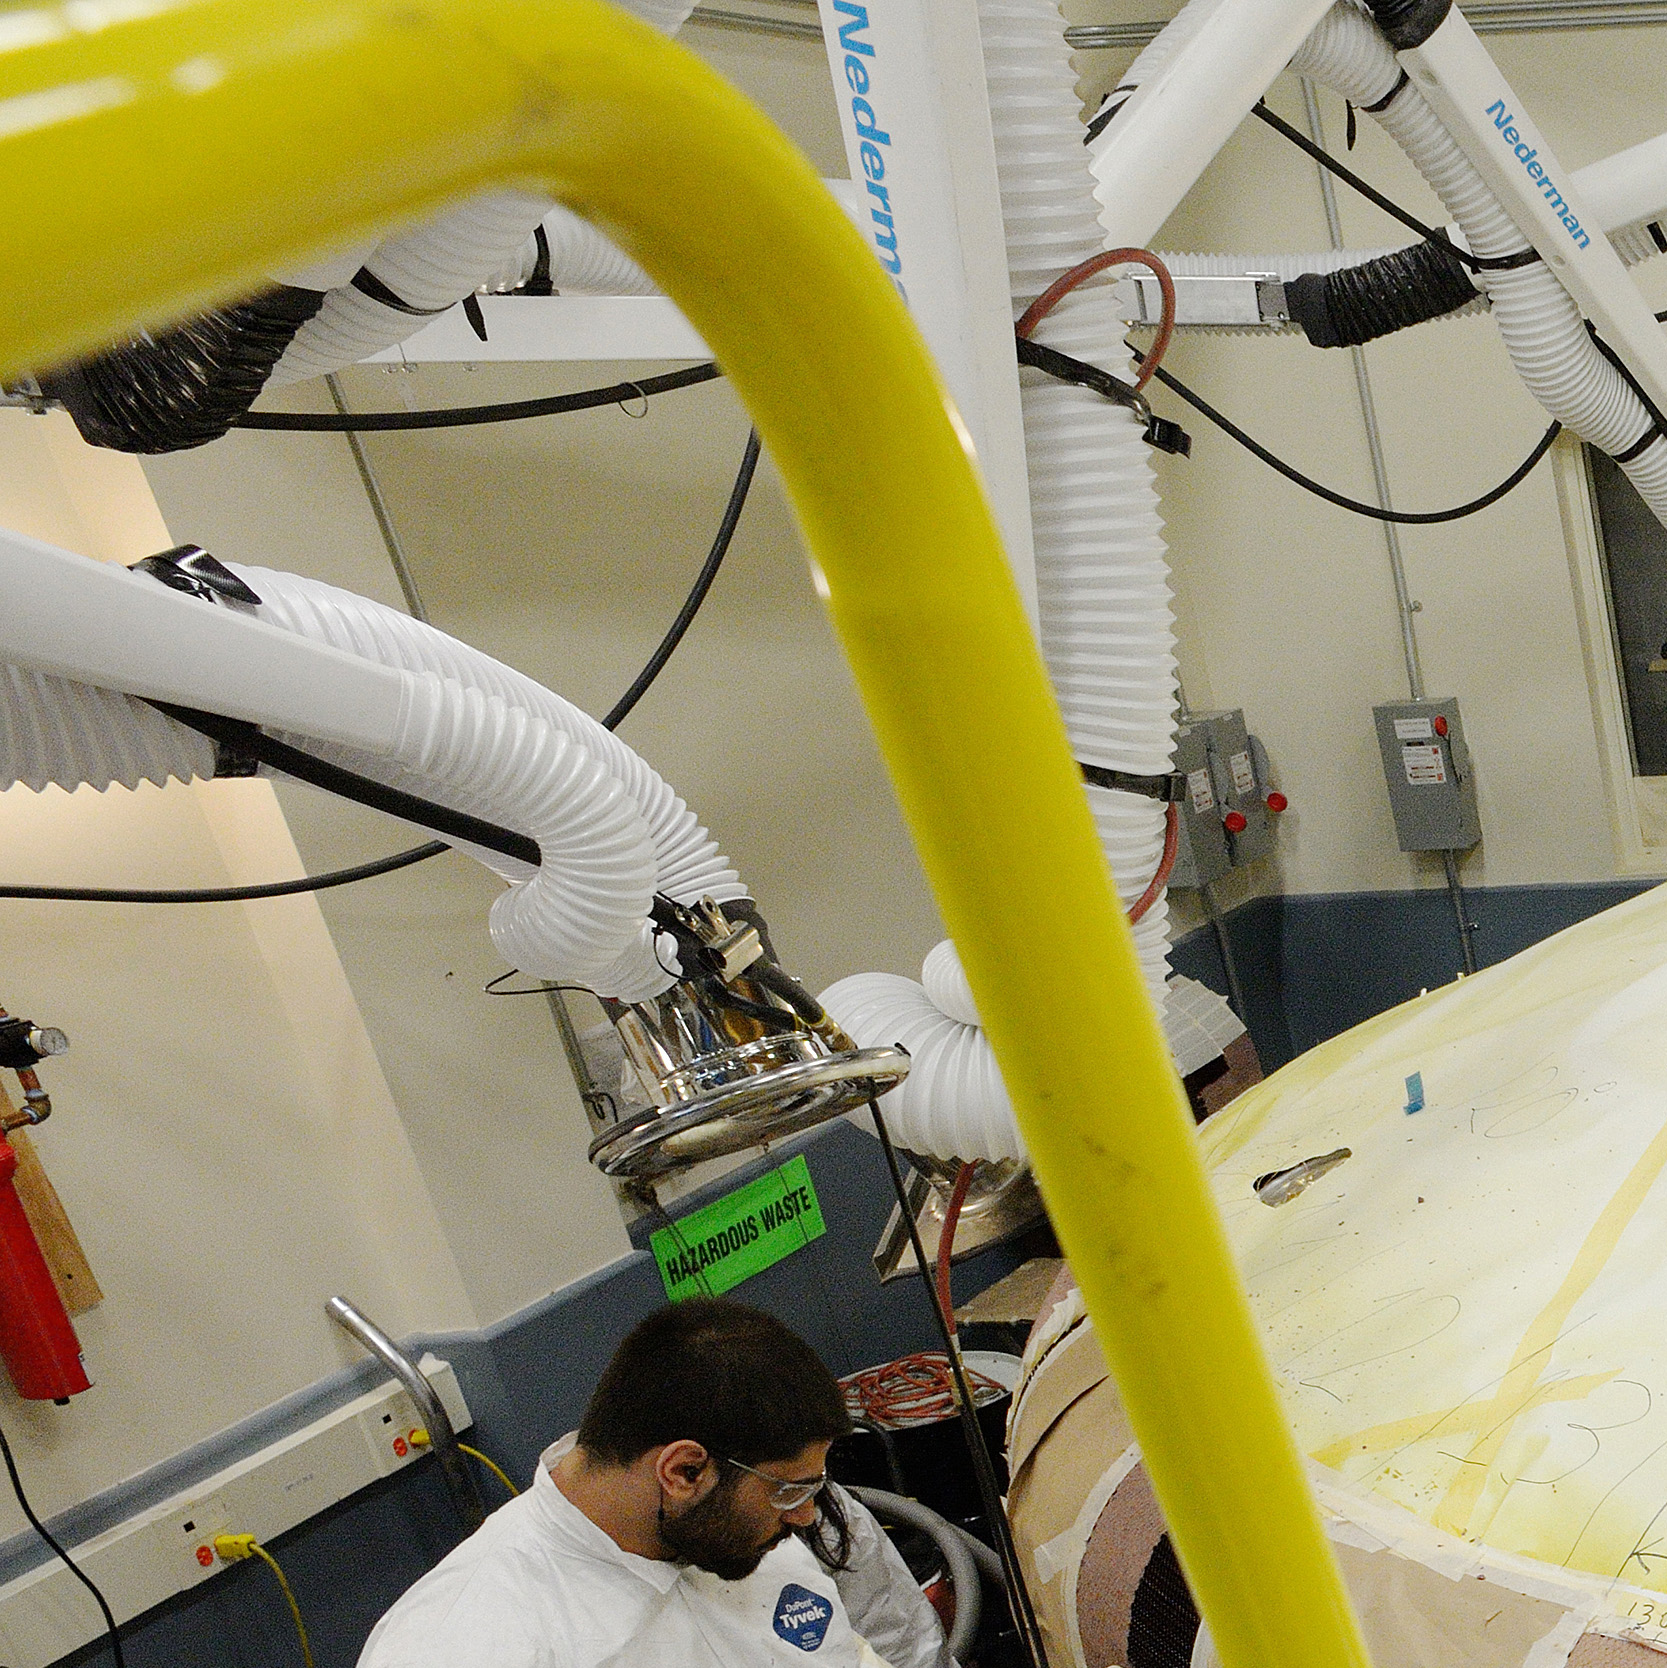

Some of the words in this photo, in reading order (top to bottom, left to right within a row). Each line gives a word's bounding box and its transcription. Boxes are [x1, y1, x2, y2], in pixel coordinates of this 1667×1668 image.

[833, 0, 909, 304] Nederm
[1485, 99, 1591, 250] Nederman
[666, 1214, 760, 1287] HAZARDOUS
[759, 1185, 812, 1234] WASTE
[779, 1605, 827, 1630] Tyvek
[785, 1598, 814, 1614] DuPont
